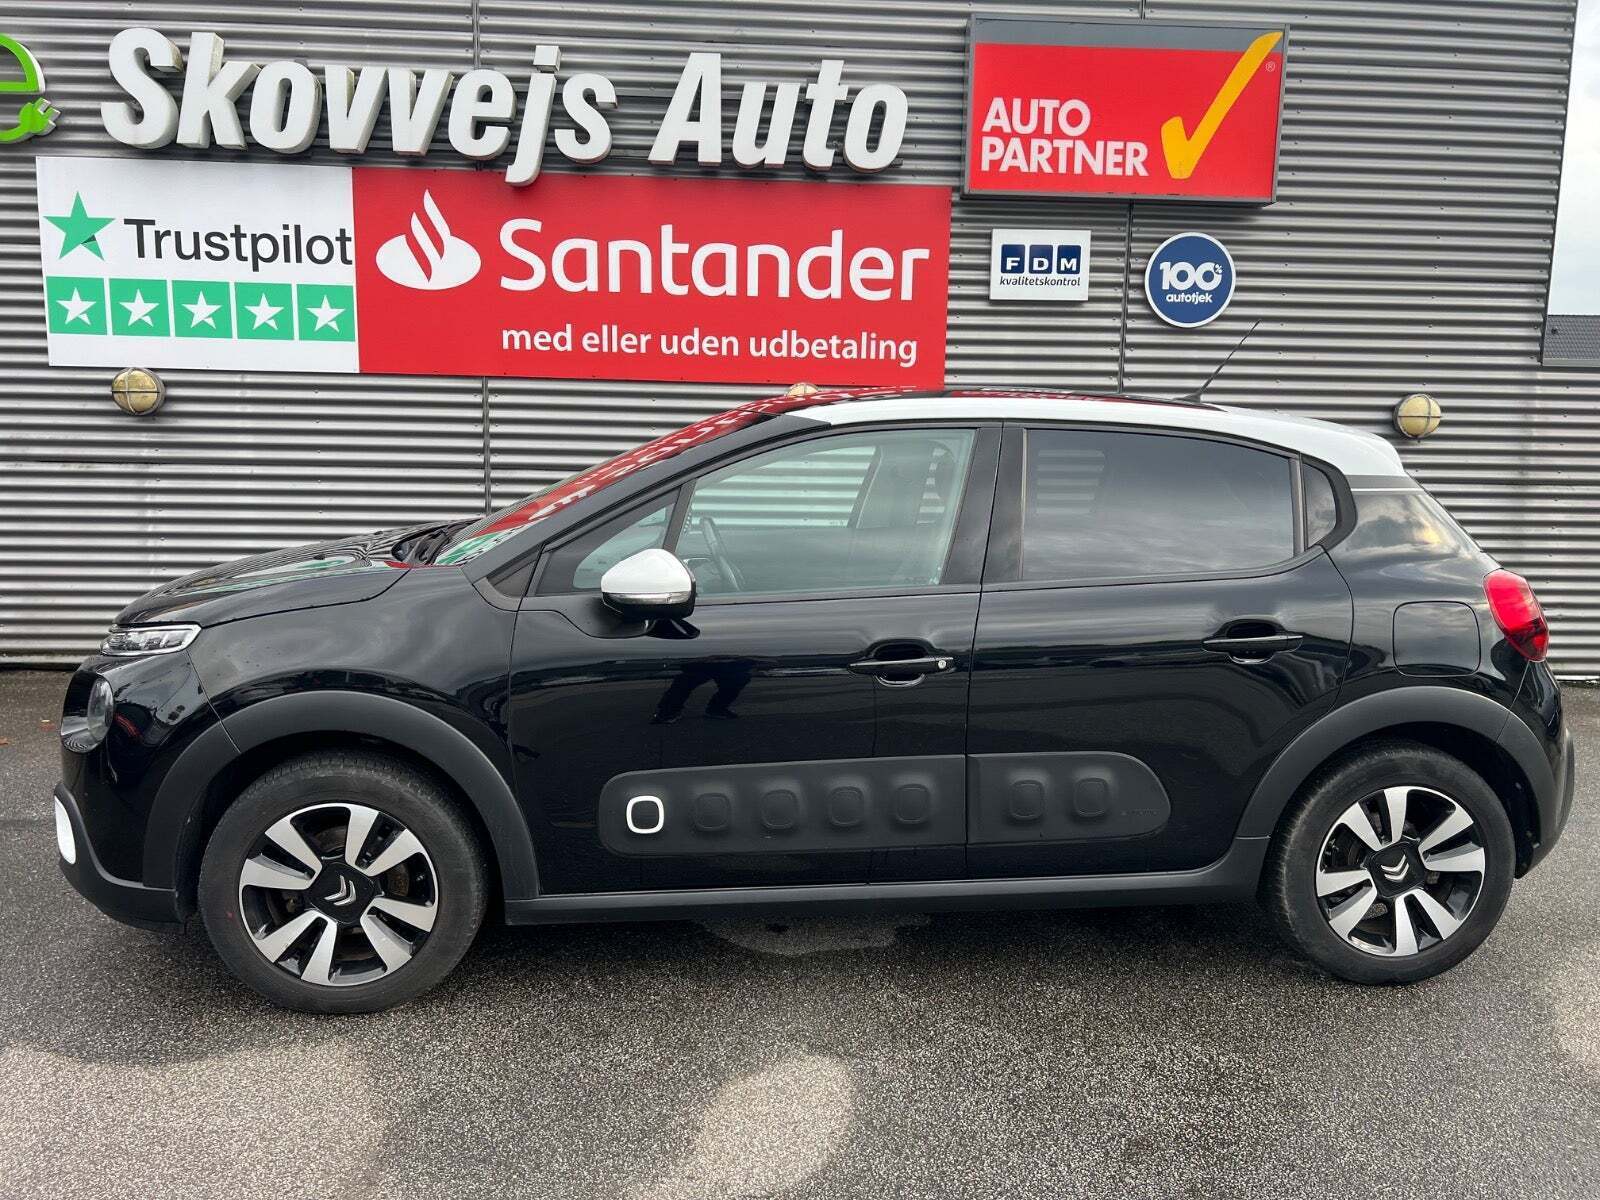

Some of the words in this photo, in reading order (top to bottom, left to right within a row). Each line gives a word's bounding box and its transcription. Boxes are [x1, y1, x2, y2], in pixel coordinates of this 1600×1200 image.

[101, 28, 618, 186] Skovvejs
[648, 52, 909, 173] Auto
[982, 97, 1091, 137] AUTO
[981, 137, 1149, 176] PARTNER
[123, 218, 353, 272] Trustpilot
[499, 218, 930, 301] Santander
[999, 276, 1081, 287] kvalitetskontrol
[1166, 292, 1213, 305] autotjek
[502, 323, 573, 352] med
[581, 324, 652, 354] eller
[660, 327, 739, 356] uden
[749, 329, 918, 368] udbetaling
